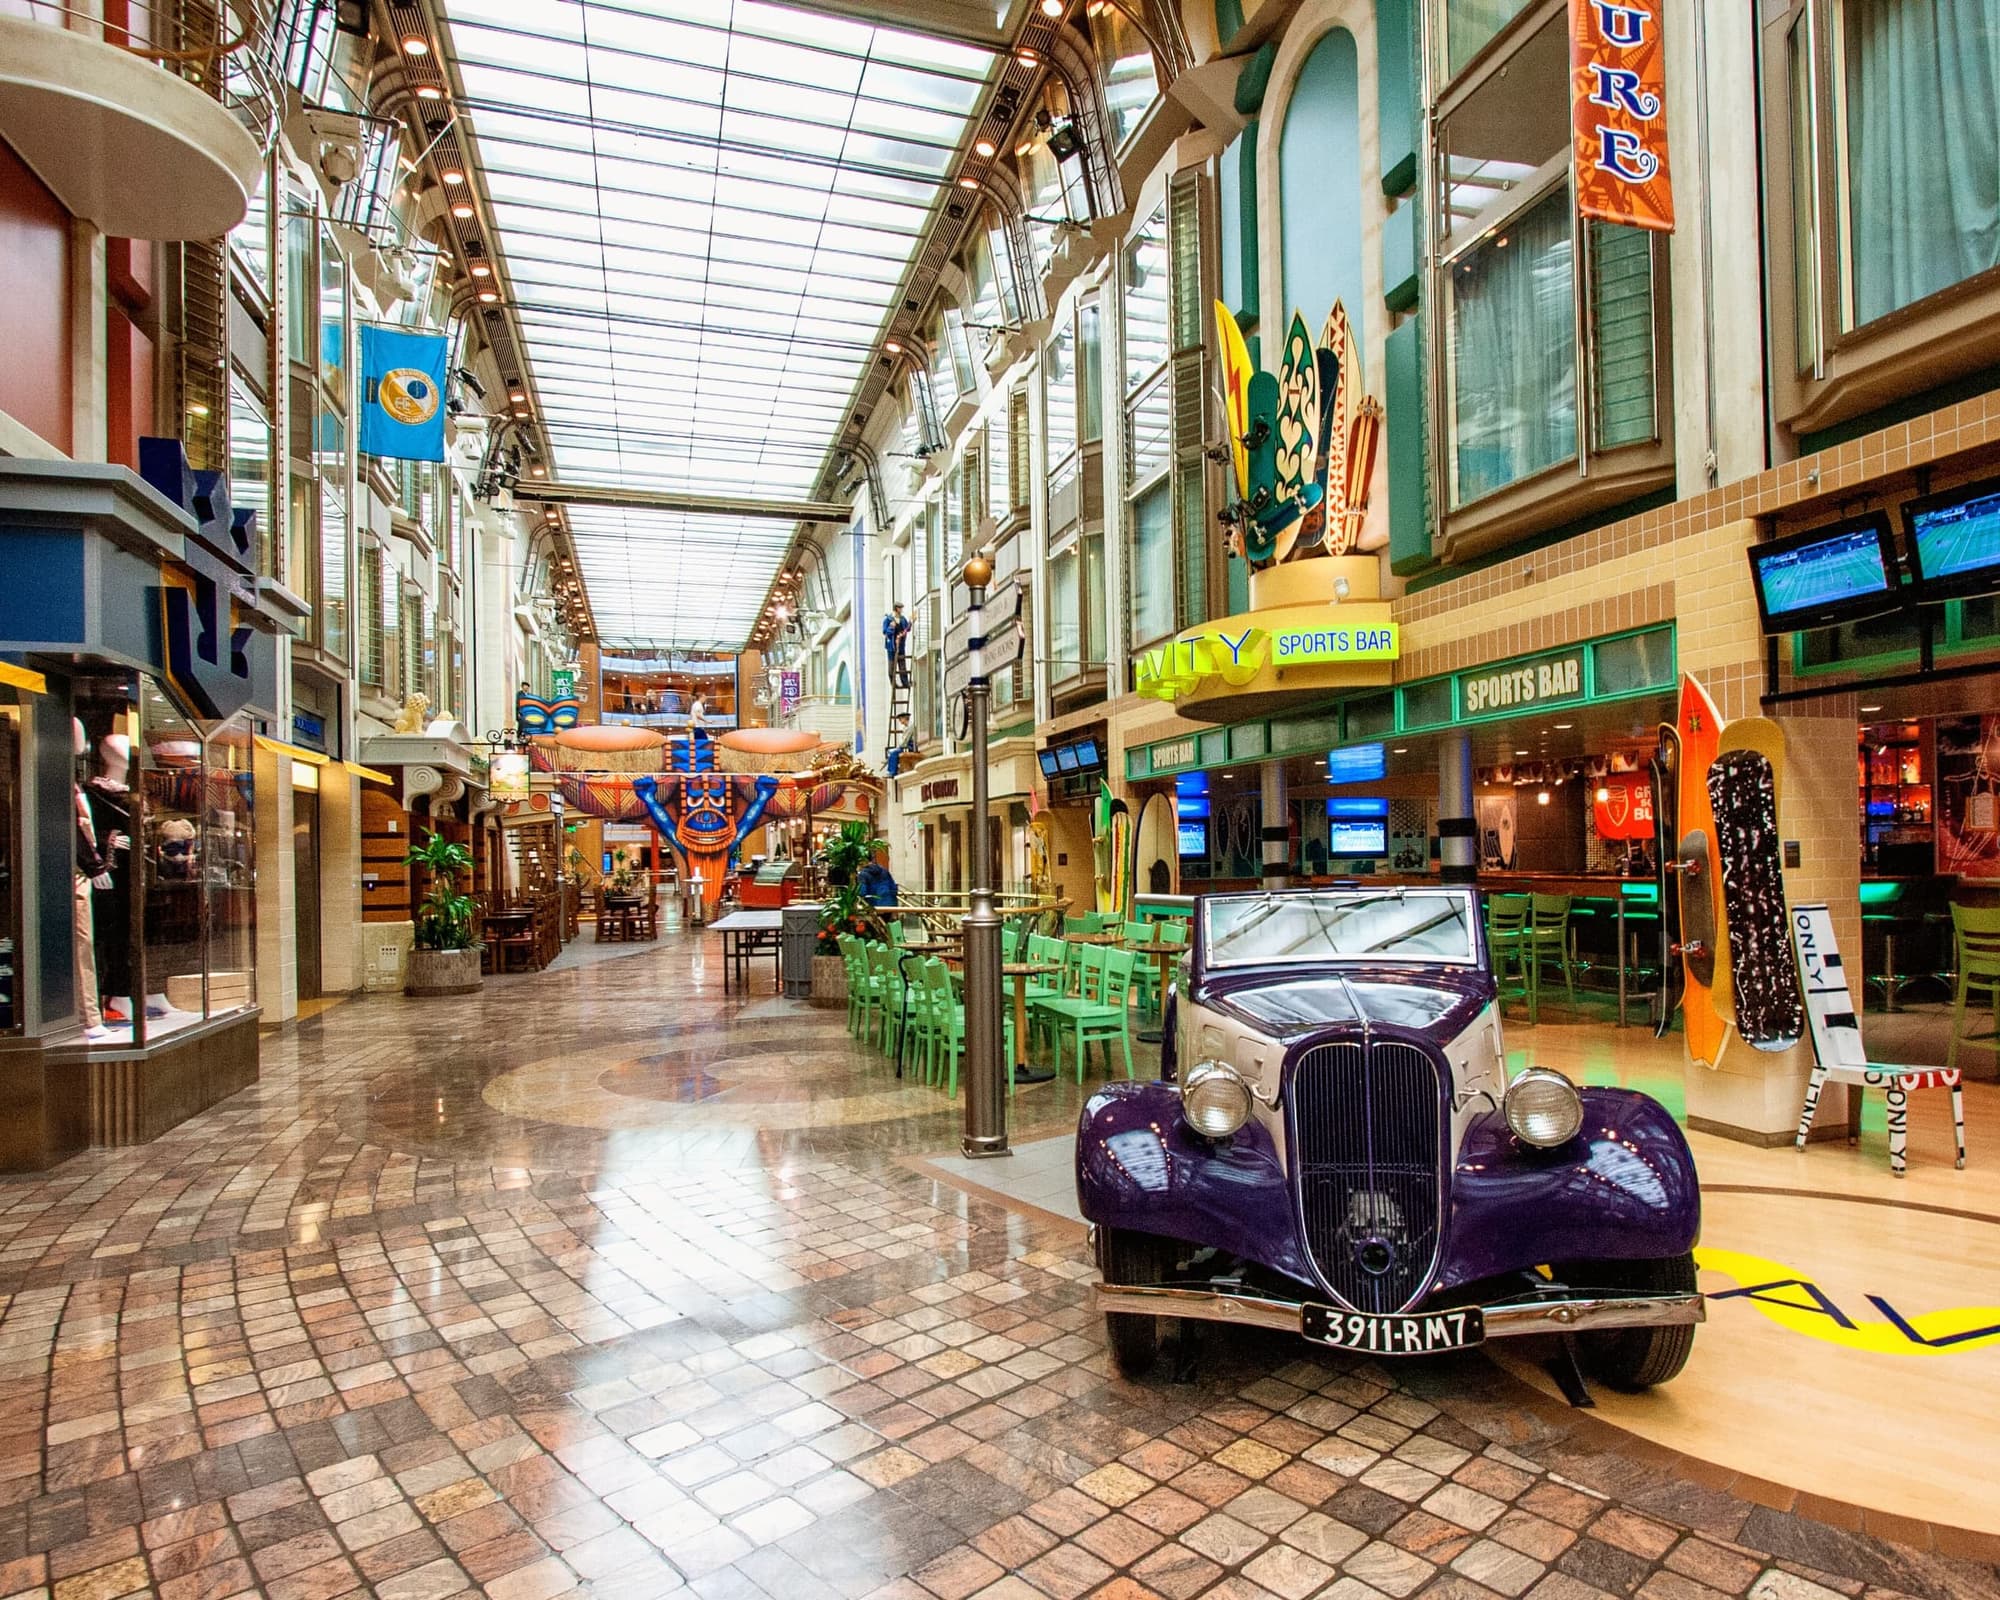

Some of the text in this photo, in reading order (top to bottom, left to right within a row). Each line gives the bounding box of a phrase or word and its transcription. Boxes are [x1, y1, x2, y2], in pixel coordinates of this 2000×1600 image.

[1278, 630, 1392, 656] SPORTS BAR
[1467, 659, 1578, 711] SPORTS BAR
[1153, 741, 1194, 768] SPORTS BAR
[1796, 914, 1824, 985] ONLY
[1324, 1311, 1467, 1352] 3911-RM7
